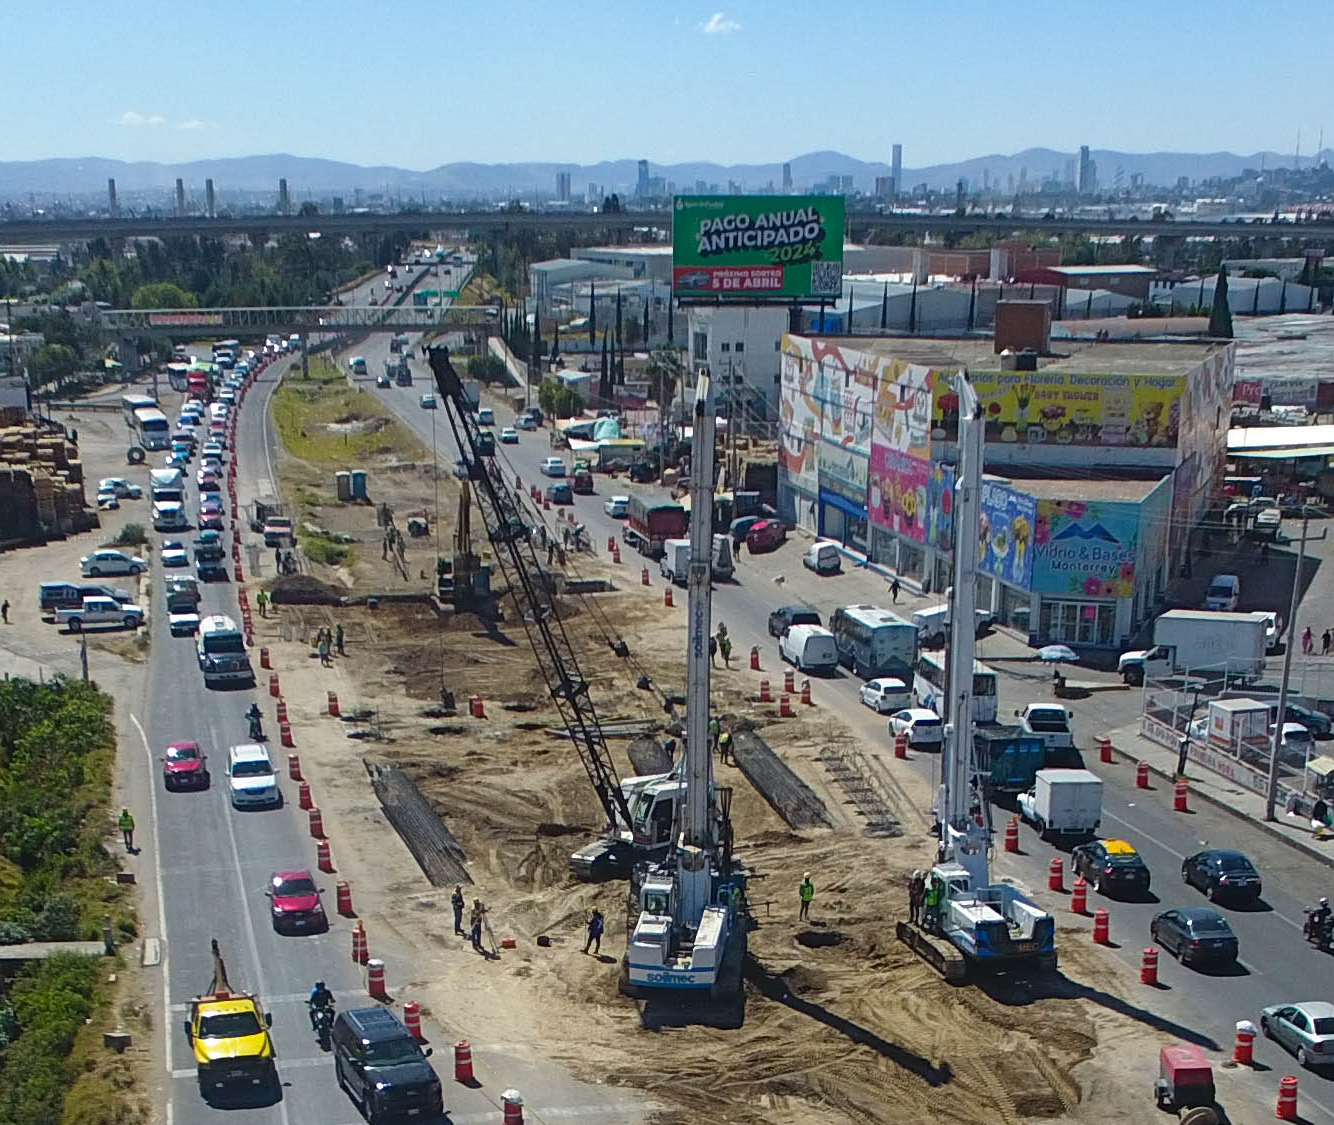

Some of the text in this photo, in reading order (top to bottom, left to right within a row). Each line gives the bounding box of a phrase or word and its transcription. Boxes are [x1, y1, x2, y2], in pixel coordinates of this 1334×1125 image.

[700, 206, 818, 235] PAGO ANUAL
[697, 223, 819, 253] ANTICIPADO
[769, 240, 816, 262] 2024
[750, 269, 782, 277] SORTEO
[712, 277, 781, 288] 5 DE ABRIL
[1144, 377, 1176, 389] Hogar
[1035, 546, 1135, 562] Vidrio & Bases
[1051, 560, 1116, 575] Monterrey
[647, 971, 696, 983] soilmec
